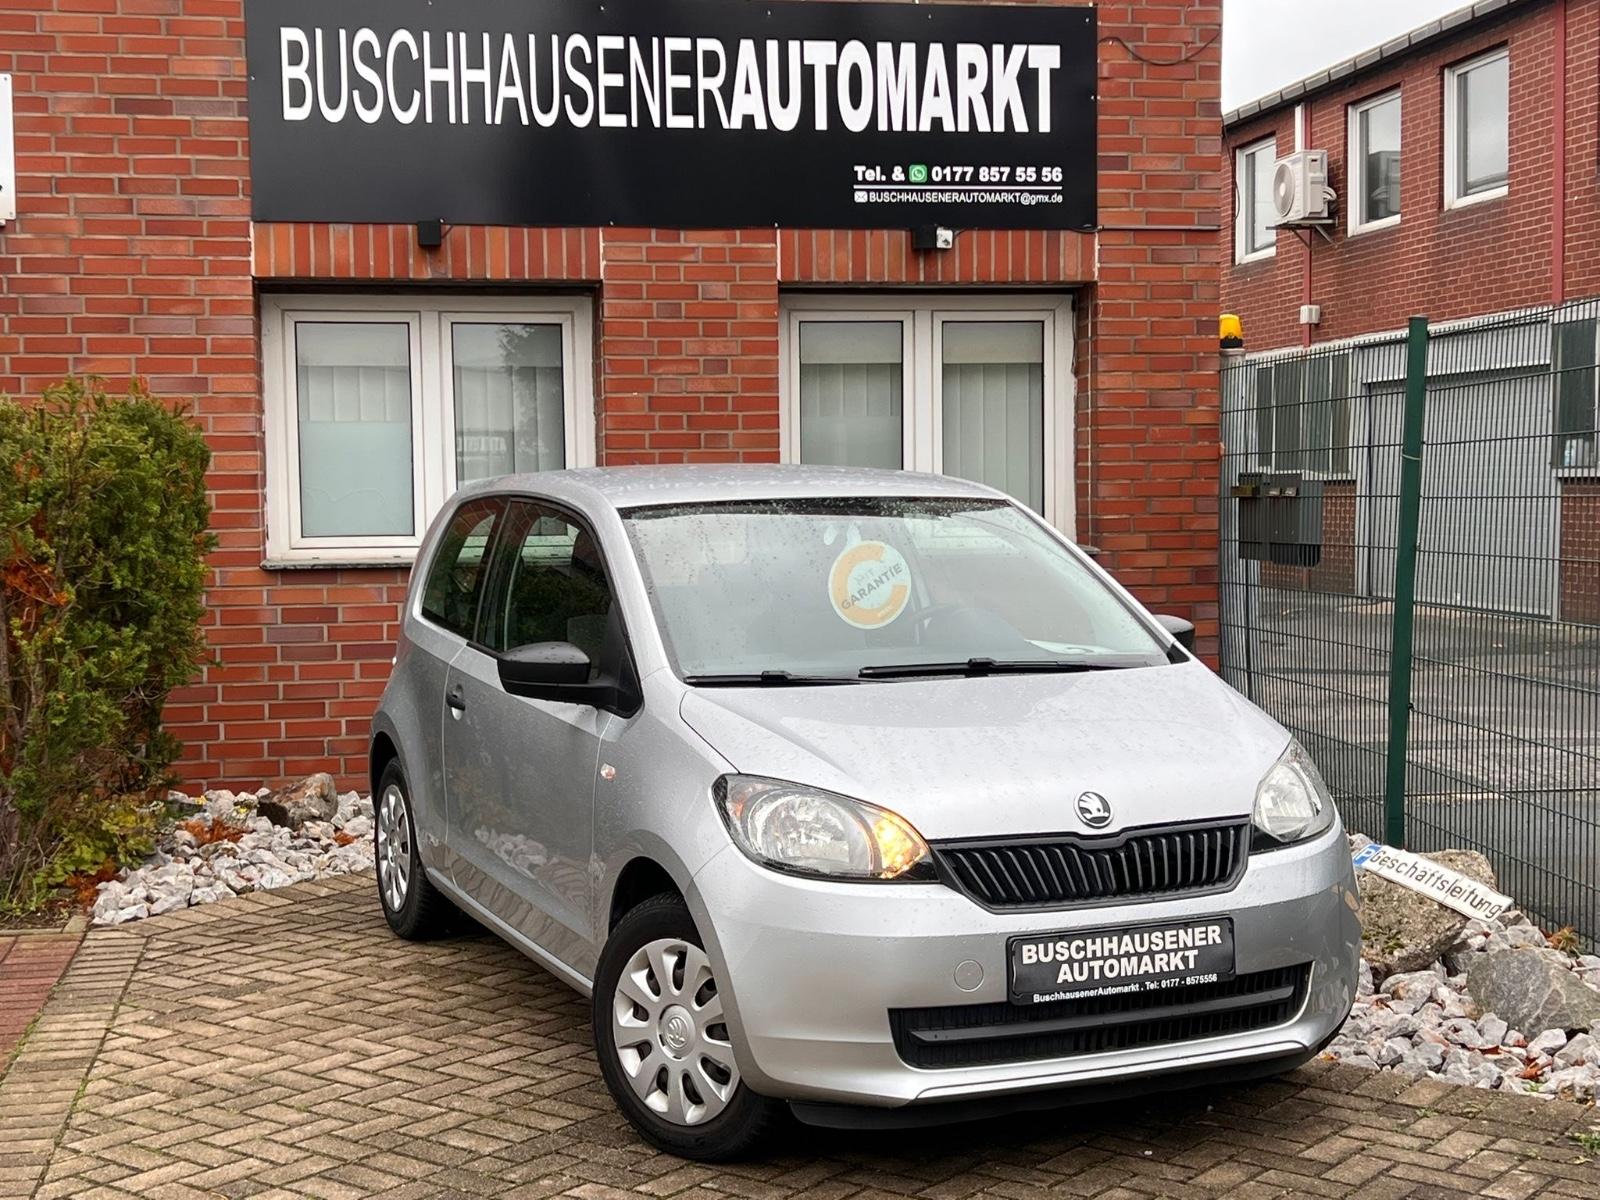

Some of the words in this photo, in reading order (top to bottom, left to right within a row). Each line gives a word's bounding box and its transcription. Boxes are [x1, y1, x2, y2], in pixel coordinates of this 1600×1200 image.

[853, 165, 886, 181] Tel.
[891, 165, 906, 182] &
[931, 166, 974, 182] 0177
[978, 166, 1010, 182] 857
[1015, 167, 1037, 182] 55
[1041, 167, 1063, 182] 56
[869, 191, 1063, 205] BUSCHHAUSENERAUTOMARKT@gmx.de
[841, 562, 903, 610] GARANTIE
[1021, 925, 1222, 965] BUSCHHAUSENER
[1056, 949, 1199, 984] AUTOMARKT
[1145, 980, 1160, 991] Tel:
[1160, 978, 1180, 989] 0177
[1185, 973, 1218, 986] 8575556
